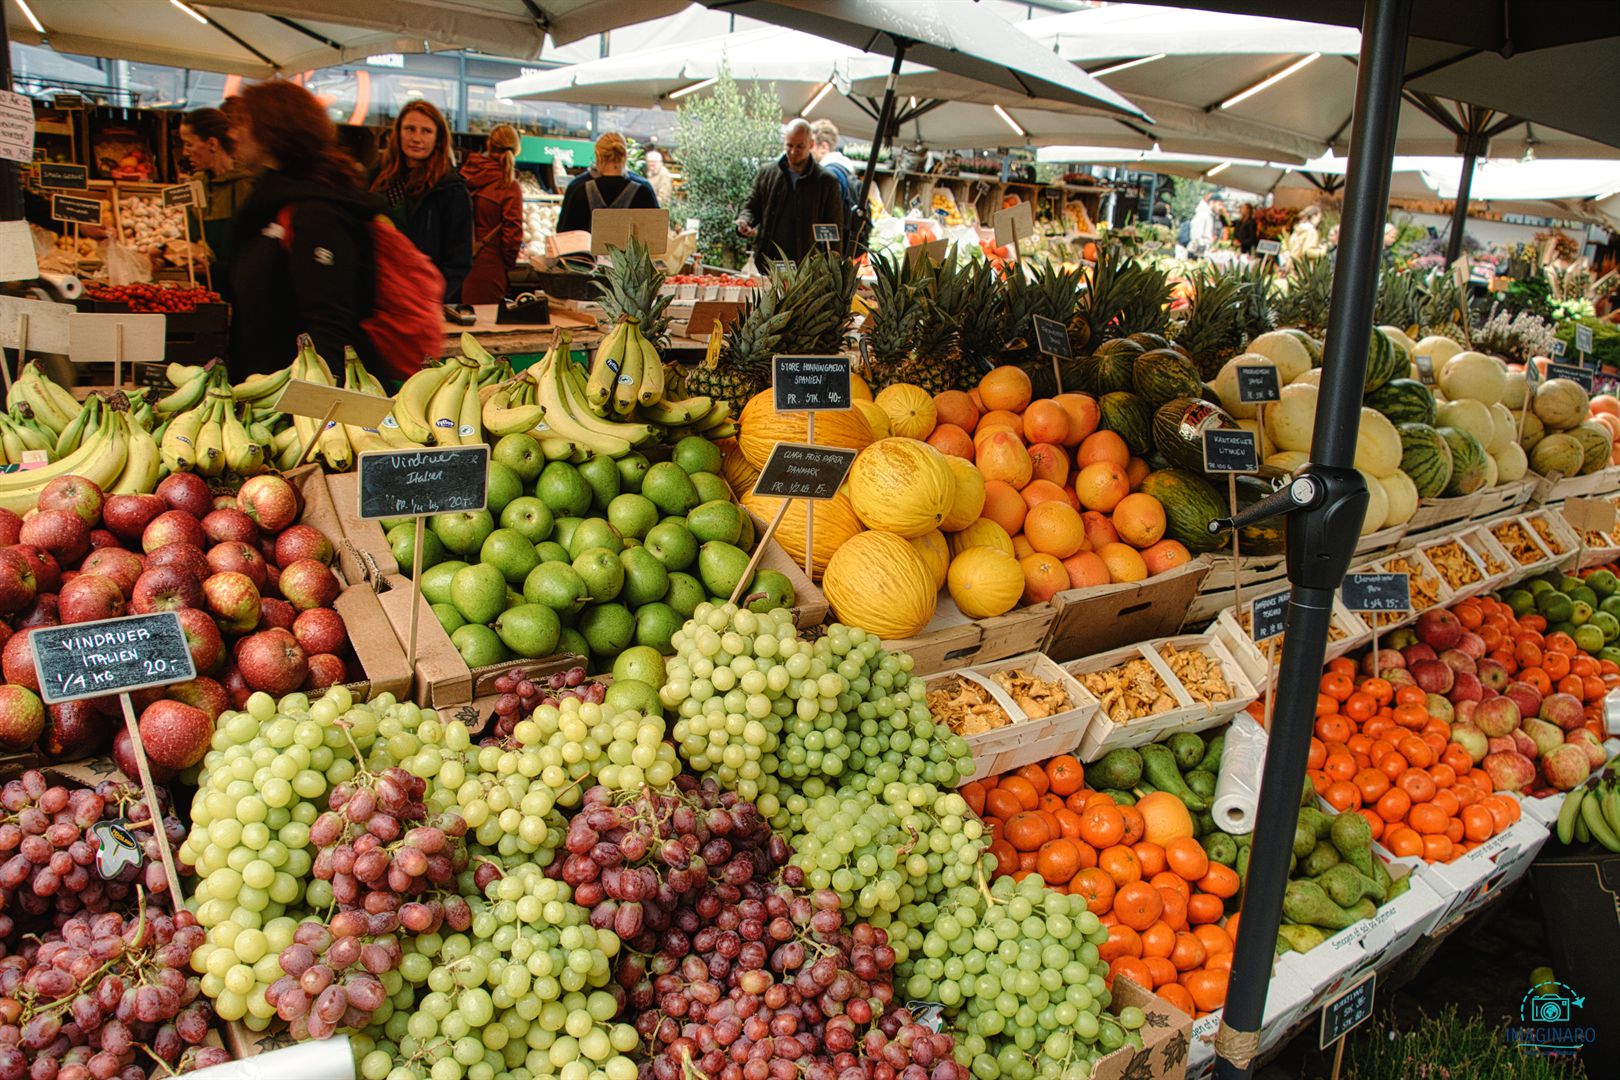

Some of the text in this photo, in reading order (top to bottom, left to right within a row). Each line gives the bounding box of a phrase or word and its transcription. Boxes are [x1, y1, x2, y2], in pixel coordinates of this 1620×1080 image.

[781, 362, 800, 372] STORE
[794, 375, 822, 384] SPANIEN
[392, 452, 459, 469] Vindruer
[783, 450, 802, 459] CLARA
[786, 465, 820, 476] DANMARK
[62, 629, 150, 650] VINDRUER
[82, 649, 138, 667] ITALIEN
[57, 673, 86, 692] 1/4
[93, 670, 114, 684] KG
[1332, 932, 1355, 950] Smagen
[1376, 907, 1397, 925] sommer
